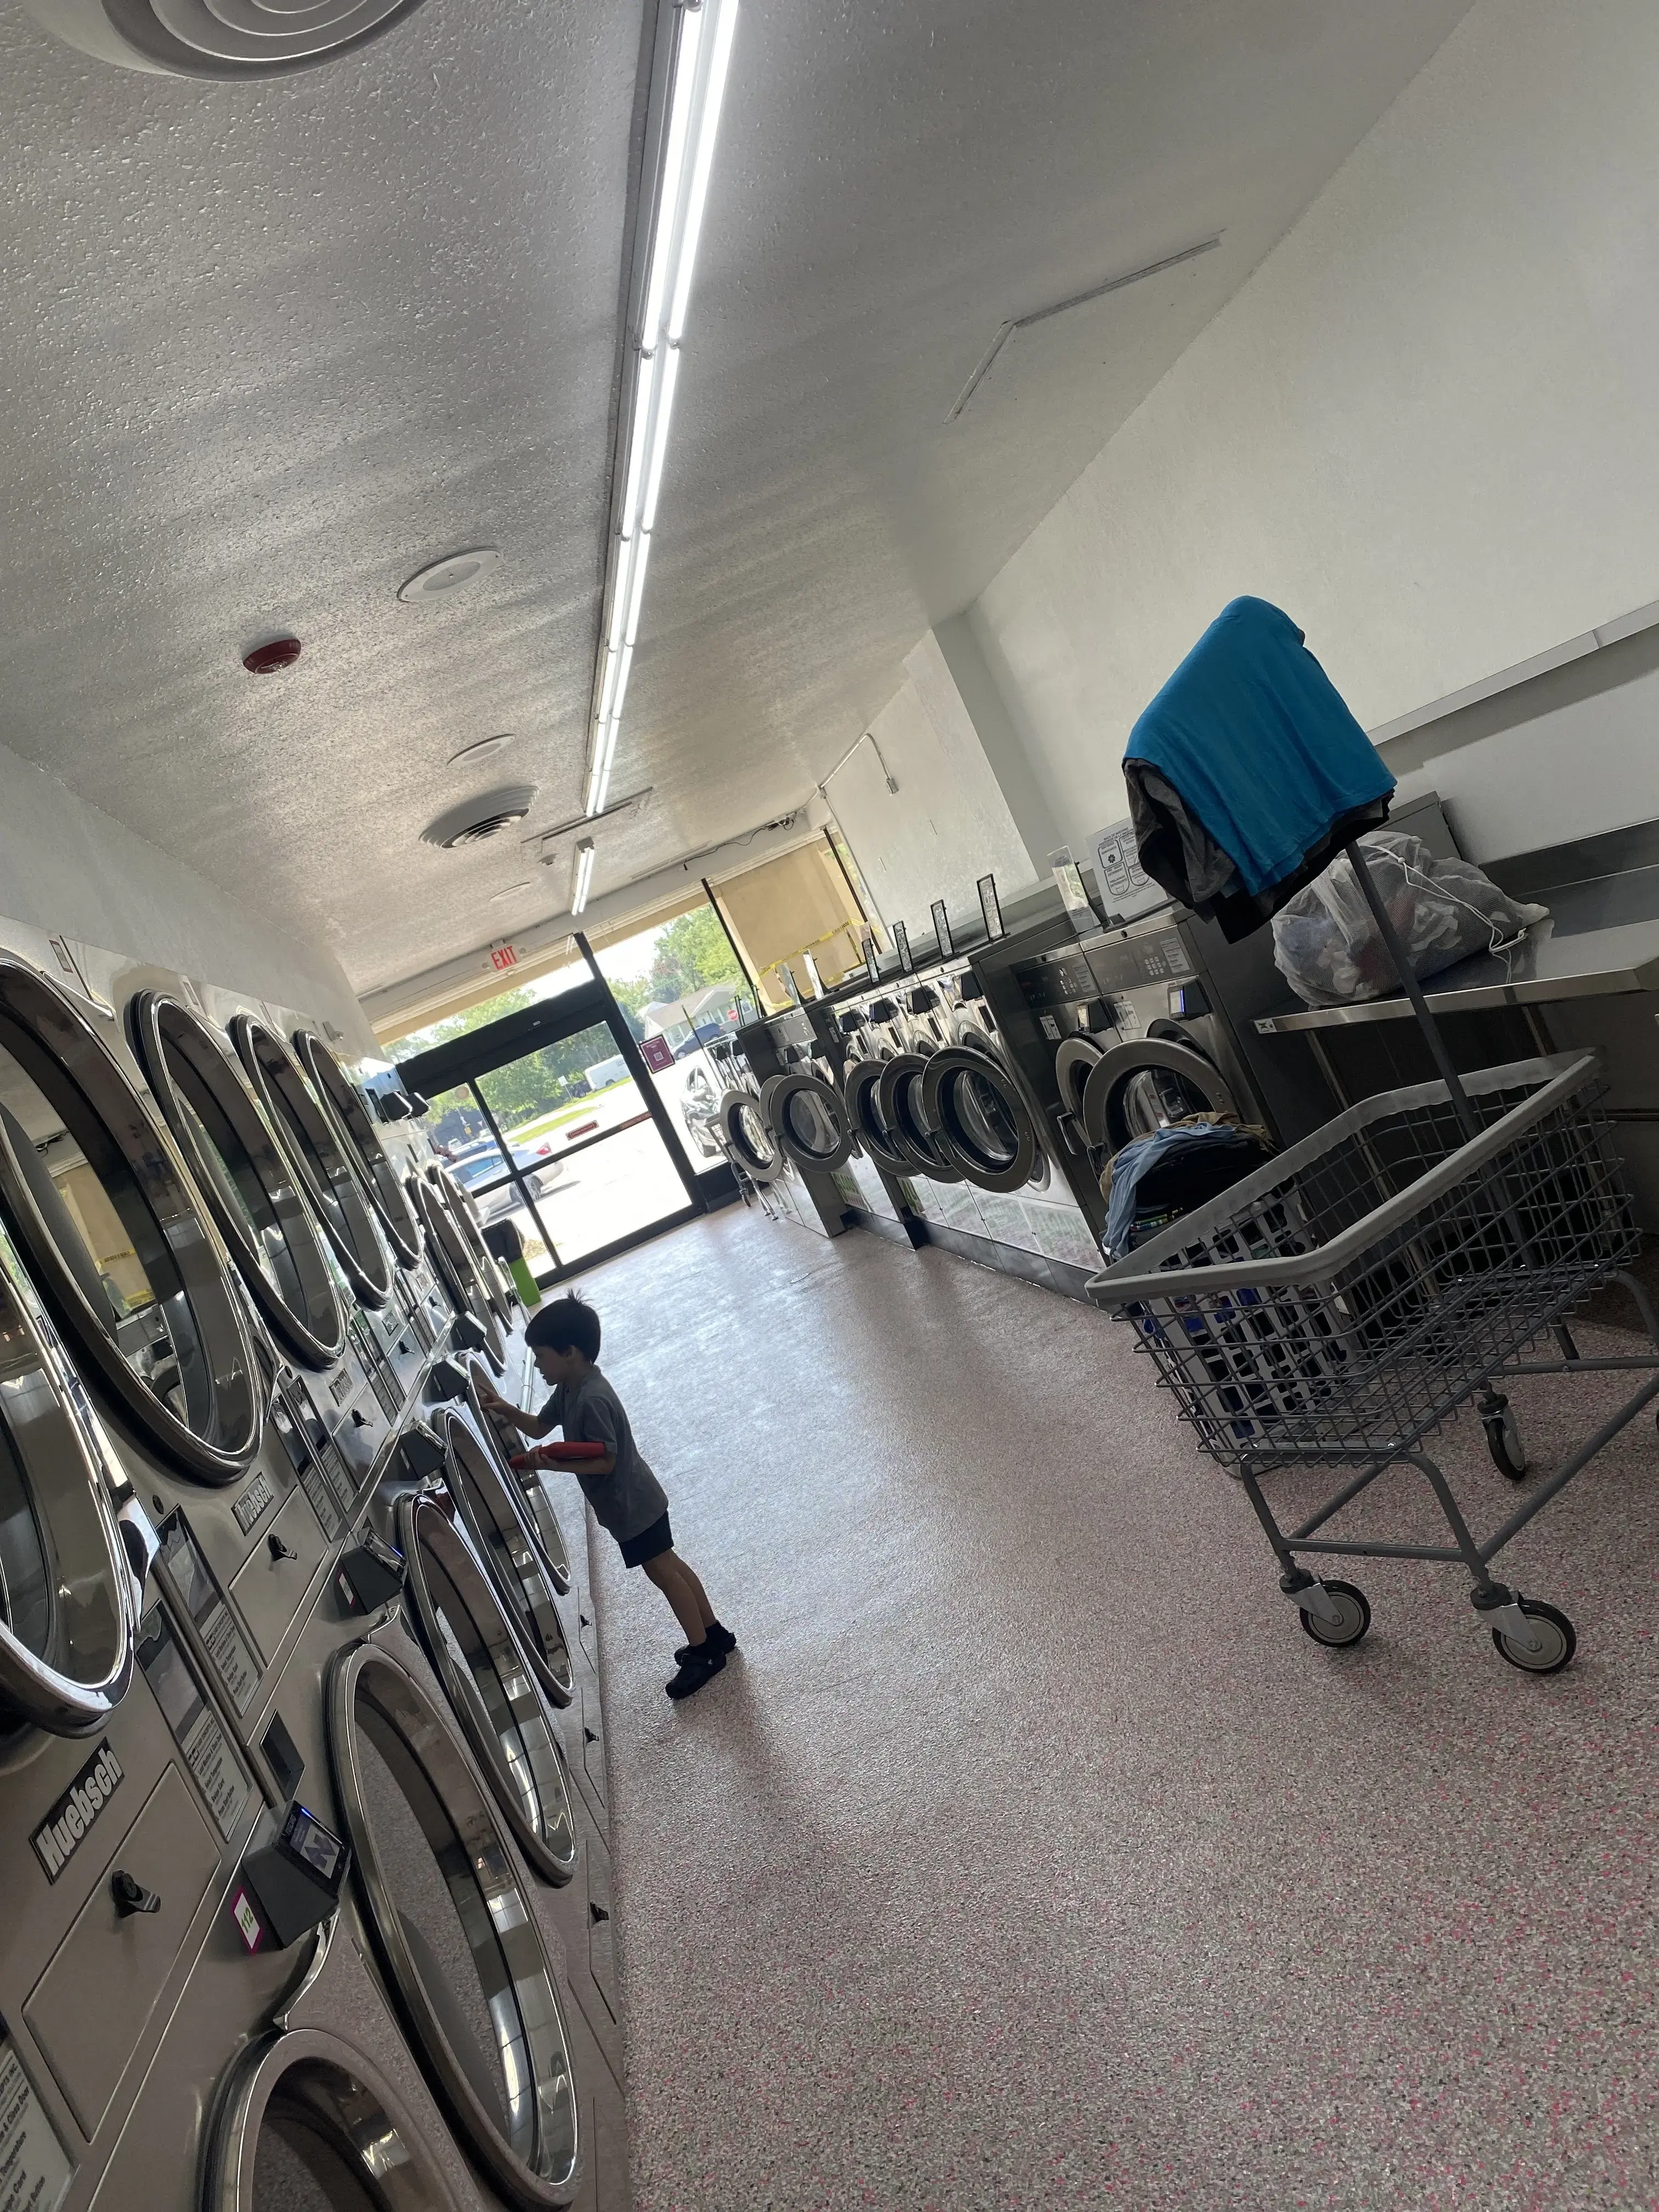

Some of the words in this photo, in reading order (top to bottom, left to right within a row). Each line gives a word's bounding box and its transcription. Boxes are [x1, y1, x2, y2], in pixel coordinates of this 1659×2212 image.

[491, 945, 517, 970] EXIT
[235, 1476, 273, 1528] Huebsch
[36, 1748, 122, 1876] Huebsch
[241, 1907, 253, 1934] 112
[13, 2170, 26, 2193] Card
